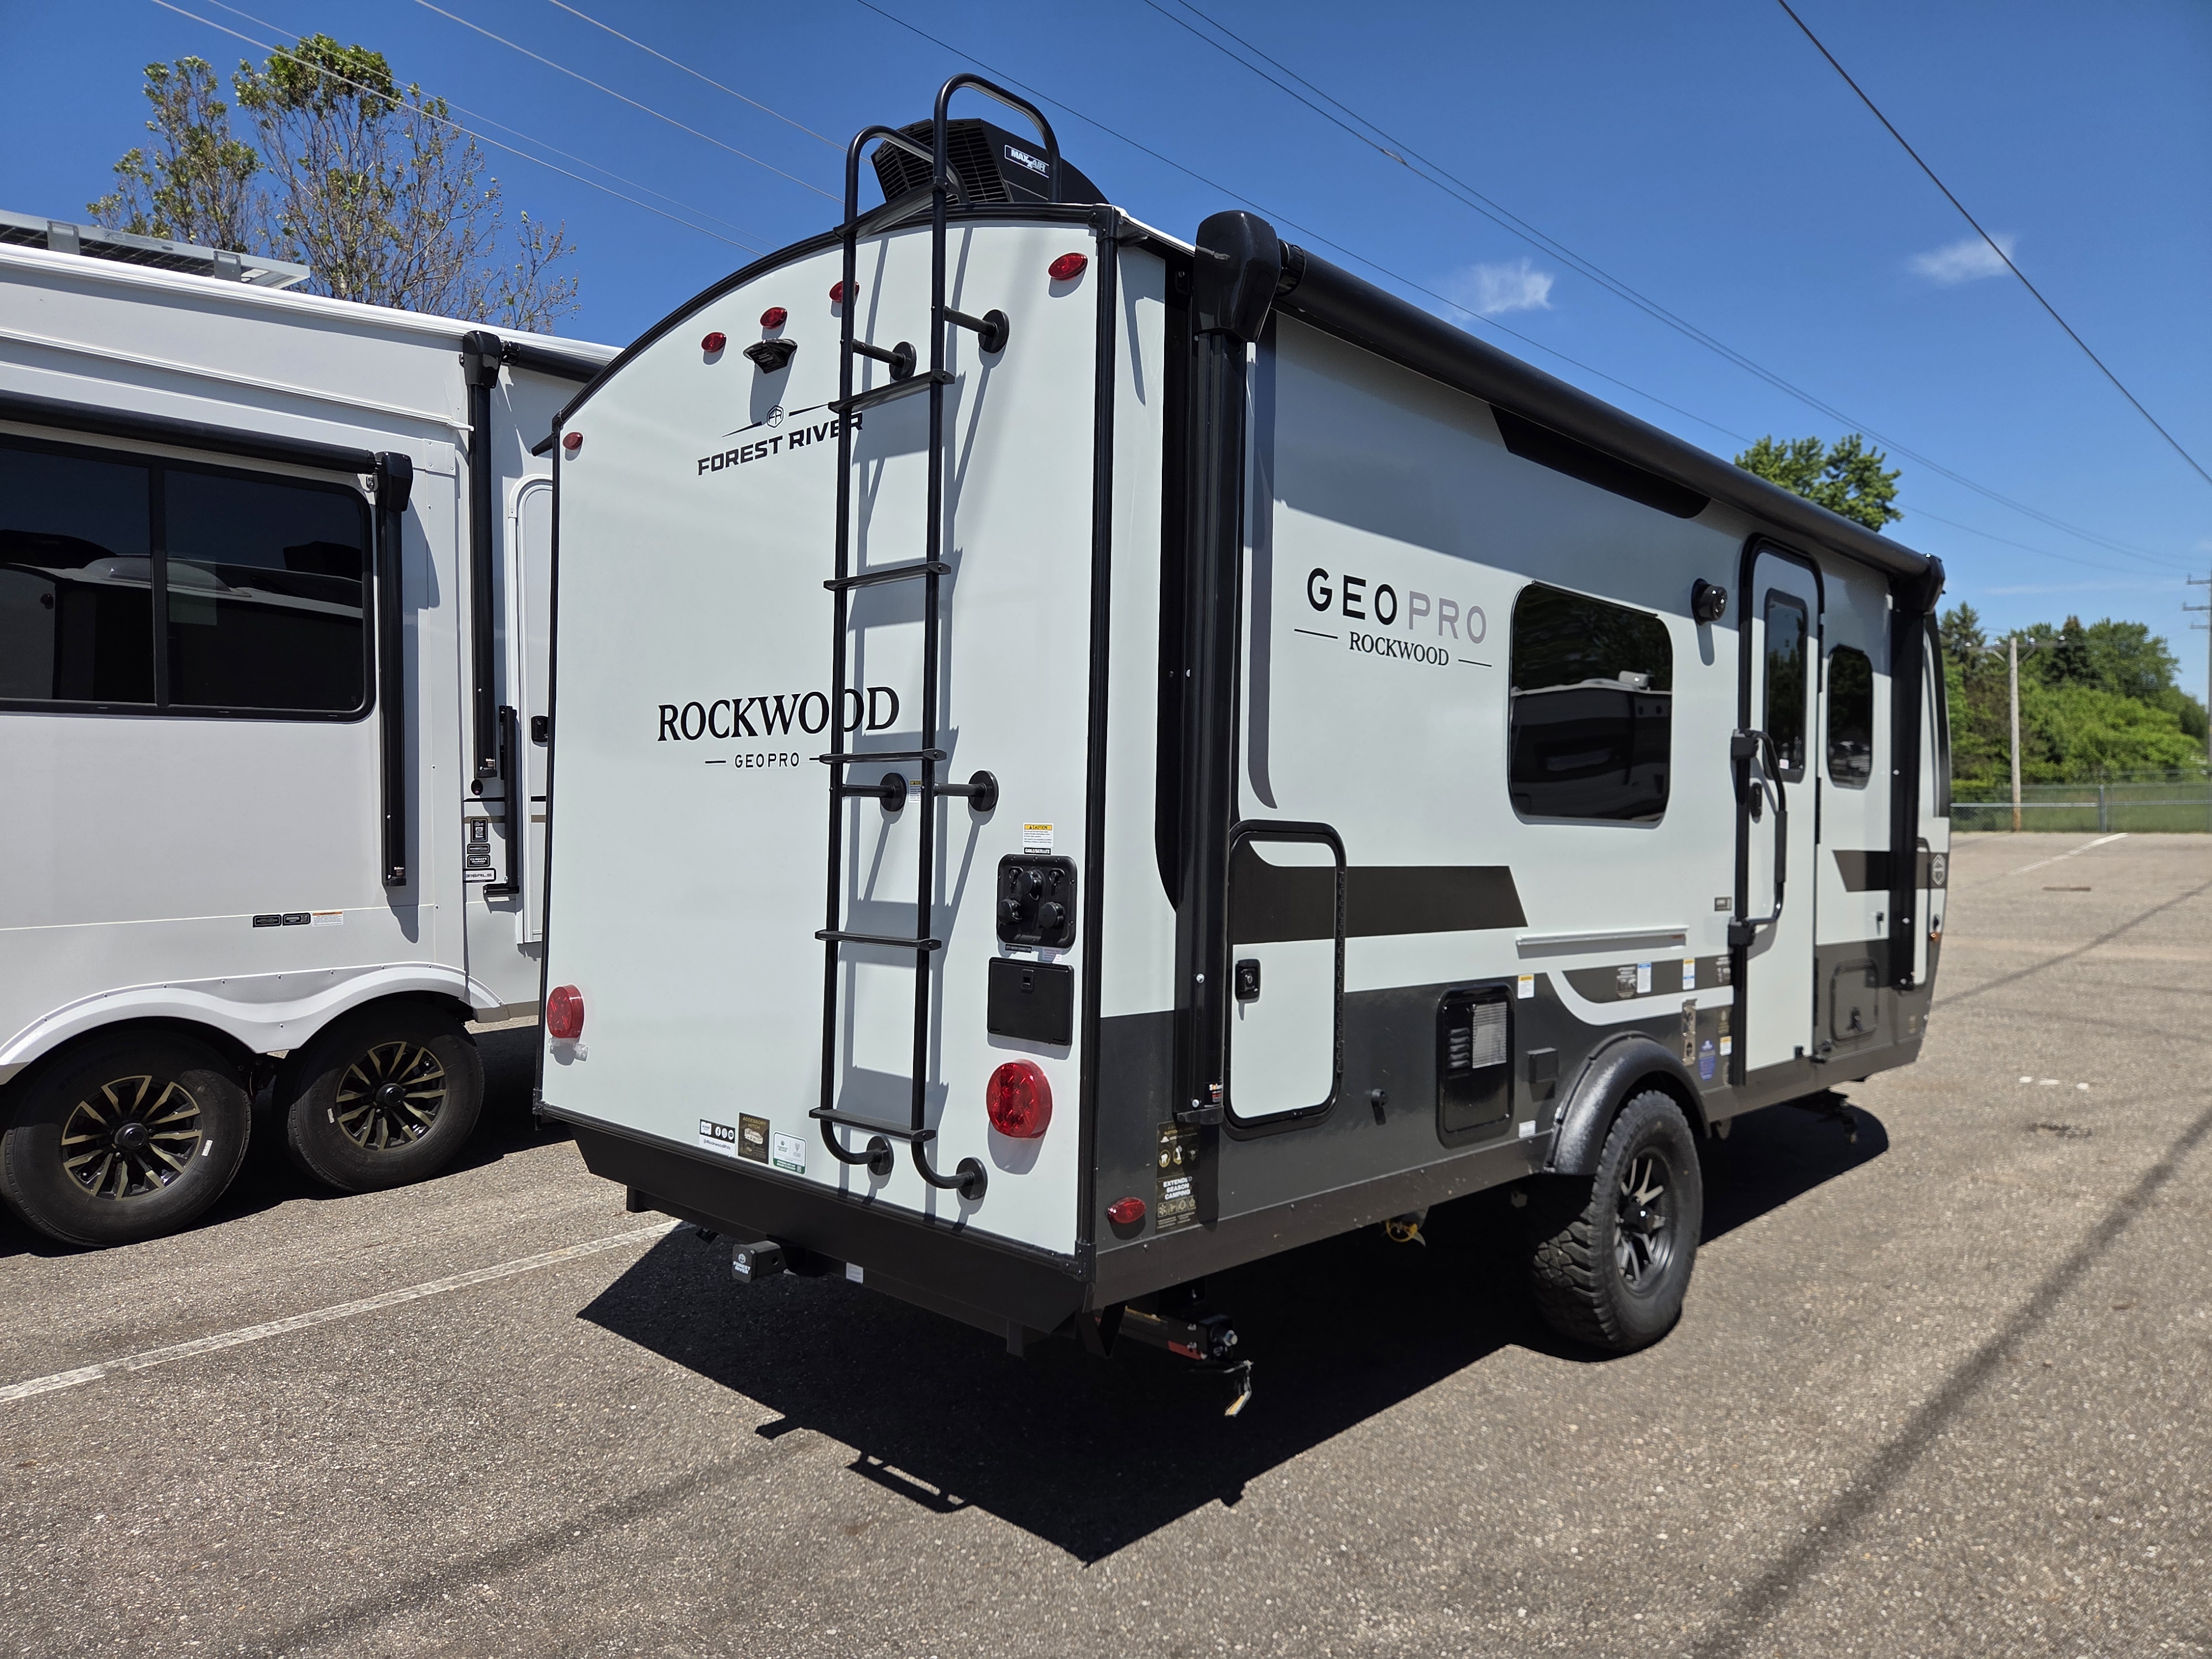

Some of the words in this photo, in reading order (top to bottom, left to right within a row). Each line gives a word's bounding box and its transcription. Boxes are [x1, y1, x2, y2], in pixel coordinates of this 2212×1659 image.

[697, 435, 783, 476] FOREST
[789, 412, 863, 450] RIVER
[1349, 631, 1449, 666] ROCKWOOD
[658, 686, 899, 741] ROCKWOOD
[735, 753, 799, 768] GEOPRO
